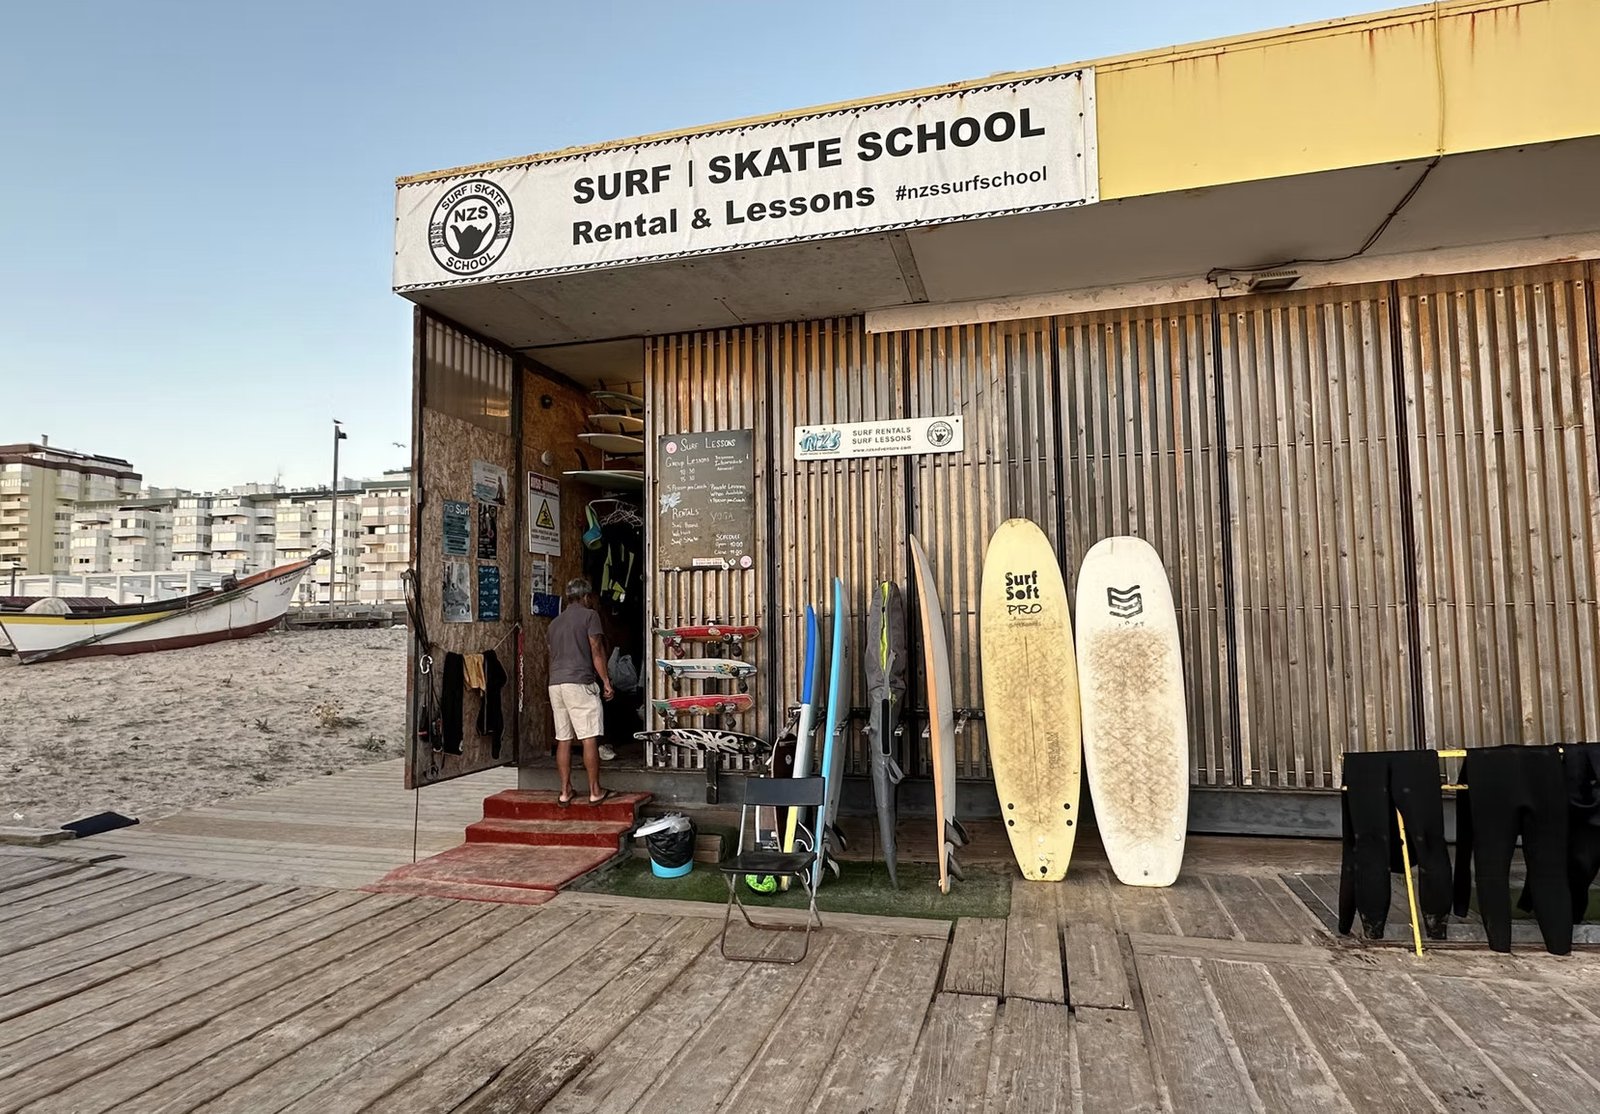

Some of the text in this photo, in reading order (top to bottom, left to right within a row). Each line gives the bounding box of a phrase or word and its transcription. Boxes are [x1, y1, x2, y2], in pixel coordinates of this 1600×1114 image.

[573, 164, 671, 204] SURF
[708, 137, 842, 184] SKATE
[857, 107, 1046, 161] SCHOOL
[441, 183, 505, 210] SURF SKATE
[454, 205, 488, 223] NZS
[572, 165, 1047, 246] Rental & Lessons #nzssurfschool
[446, 252, 496, 270] SCHOOL
[874, 435, 912, 443] LESSONS
[875, 426, 911, 435] RENTALS
[1005, 570, 1037, 586] Surf
[1006, 585, 1040, 601] Soft
[1006, 603, 1043, 615] PRO
